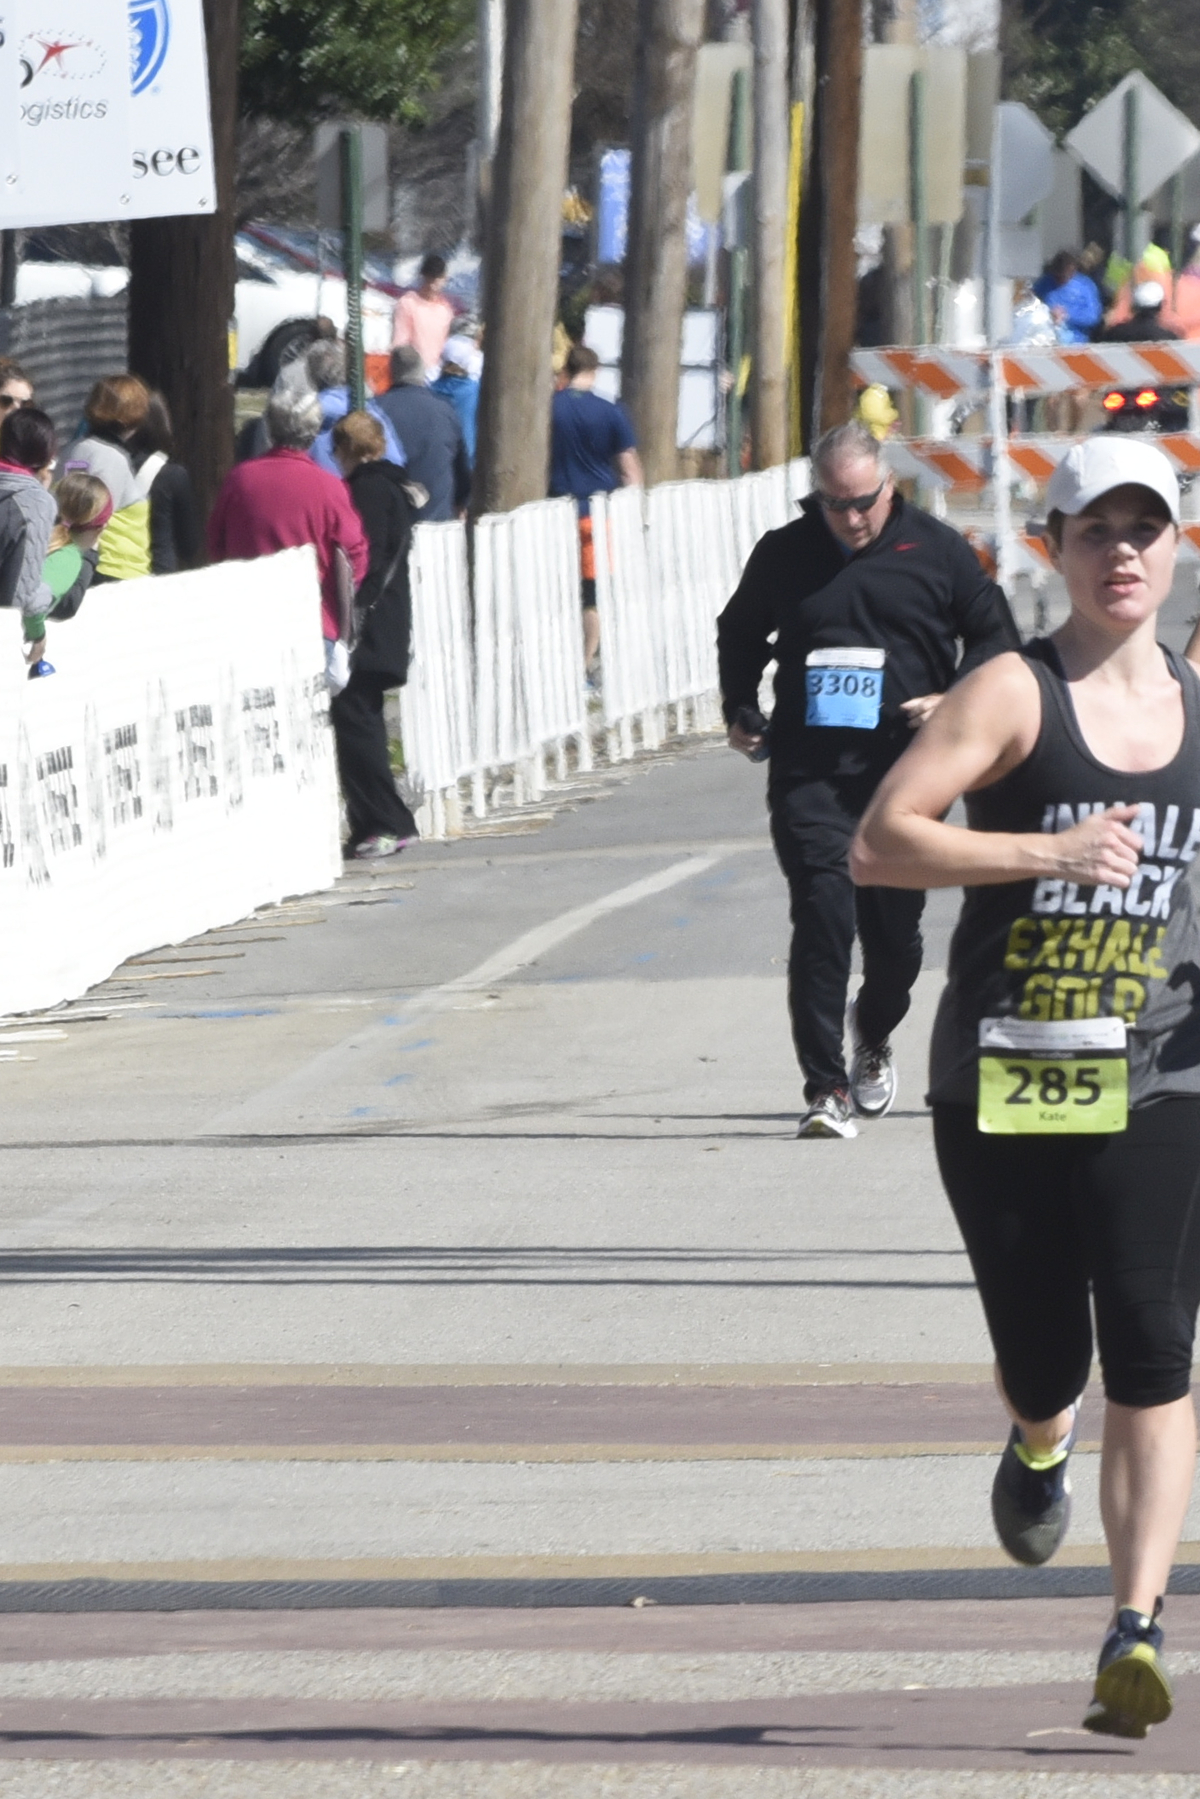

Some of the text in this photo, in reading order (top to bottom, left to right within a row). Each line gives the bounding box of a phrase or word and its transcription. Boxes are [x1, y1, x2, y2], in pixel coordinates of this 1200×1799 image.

[808, 674, 877, 698] 3308
[1005, 1065, 1102, 1106] 285
[1038, 1111, 1068, 1123] Kate
